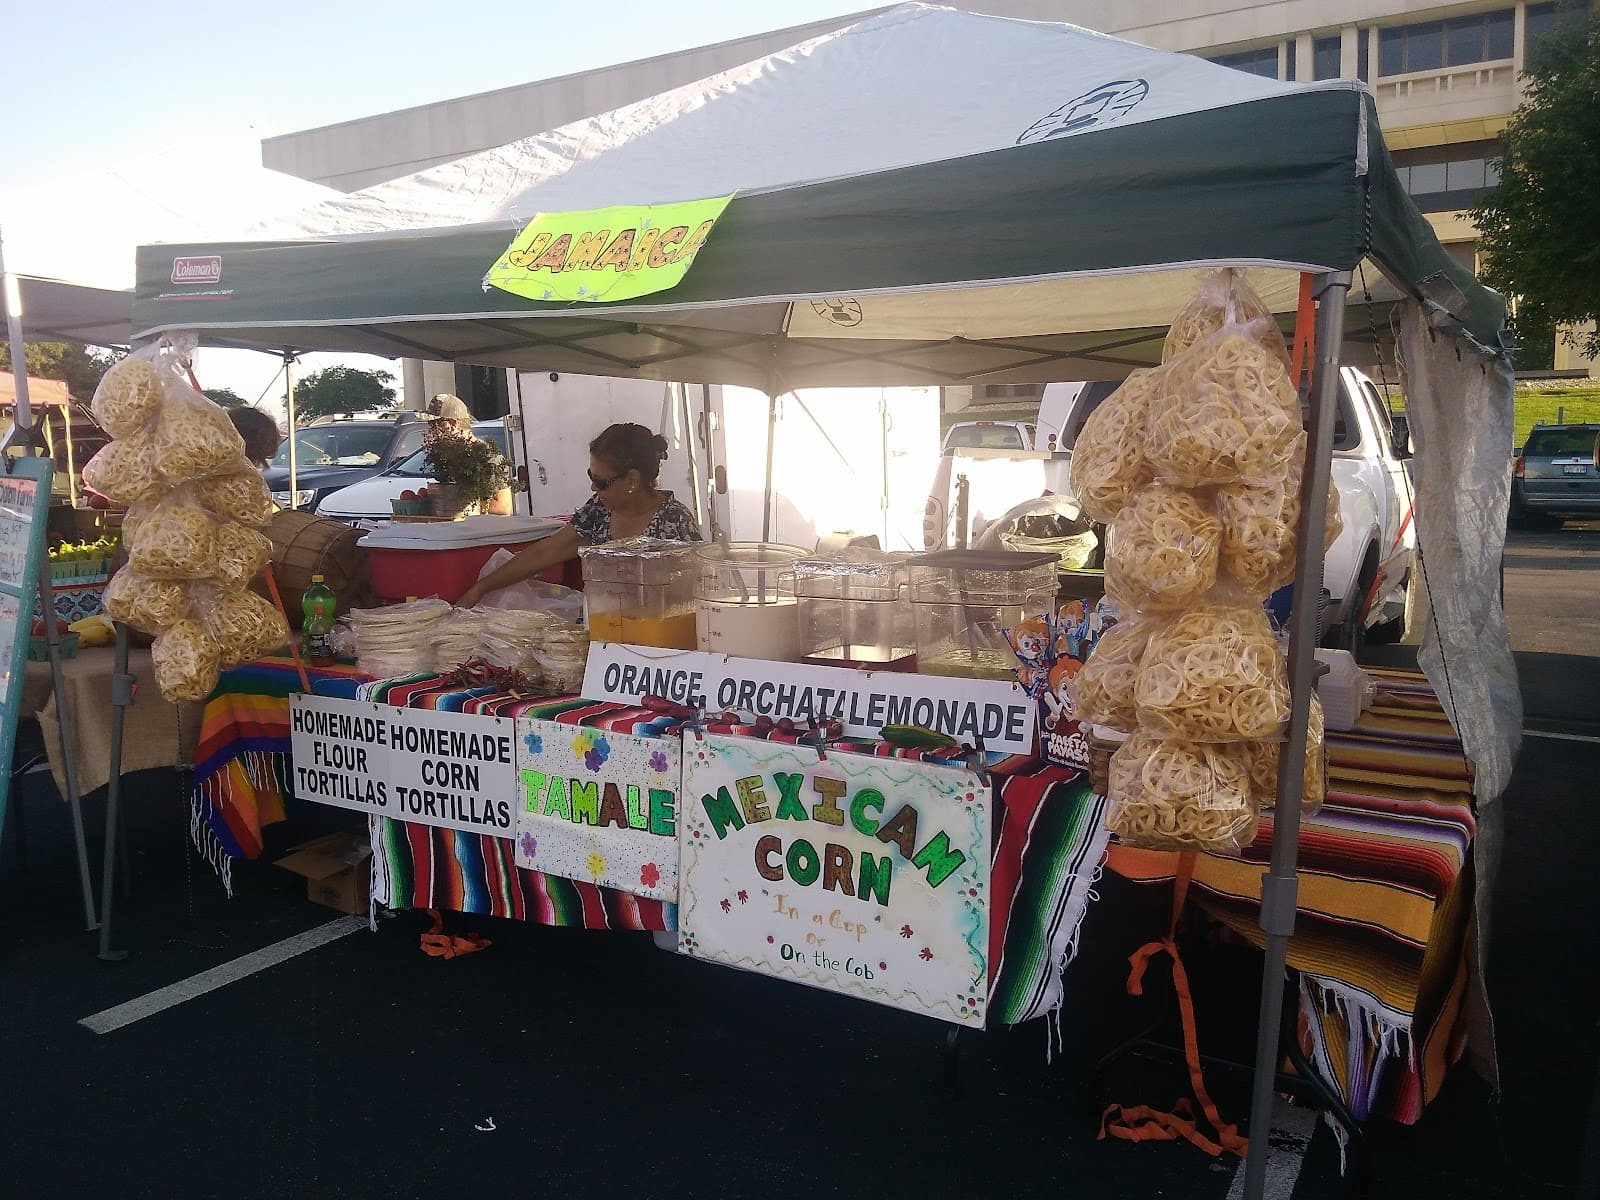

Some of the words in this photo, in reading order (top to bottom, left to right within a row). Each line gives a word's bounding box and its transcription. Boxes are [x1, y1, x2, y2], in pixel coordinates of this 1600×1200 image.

[176, 260, 211, 277] Coleman
[293, 708, 387, 745] HOMEMADE
[848, 691, 1027, 742] LEMONADE
[314, 740, 369, 774] FLOUR
[391, 726, 511, 764] HOMEMADE
[298, 767, 387, 807] TORTILLAS
[422, 760, 480, 792] CORN
[396, 786, 511, 828] TORTILLAS
[520, 768, 676, 837] TAMALE
[701, 771, 967, 888] MEXICAN
[754, 835, 893, 906] CORN
[773, 894, 799, 920] In
[812, 914, 823, 925] a
[829, 909, 867, 943] Cup
[806, 932, 826, 947] Or
[780, 943, 806, 964] On
[812, 950, 840, 971] the
[845, 957, 874, 980] Cob
